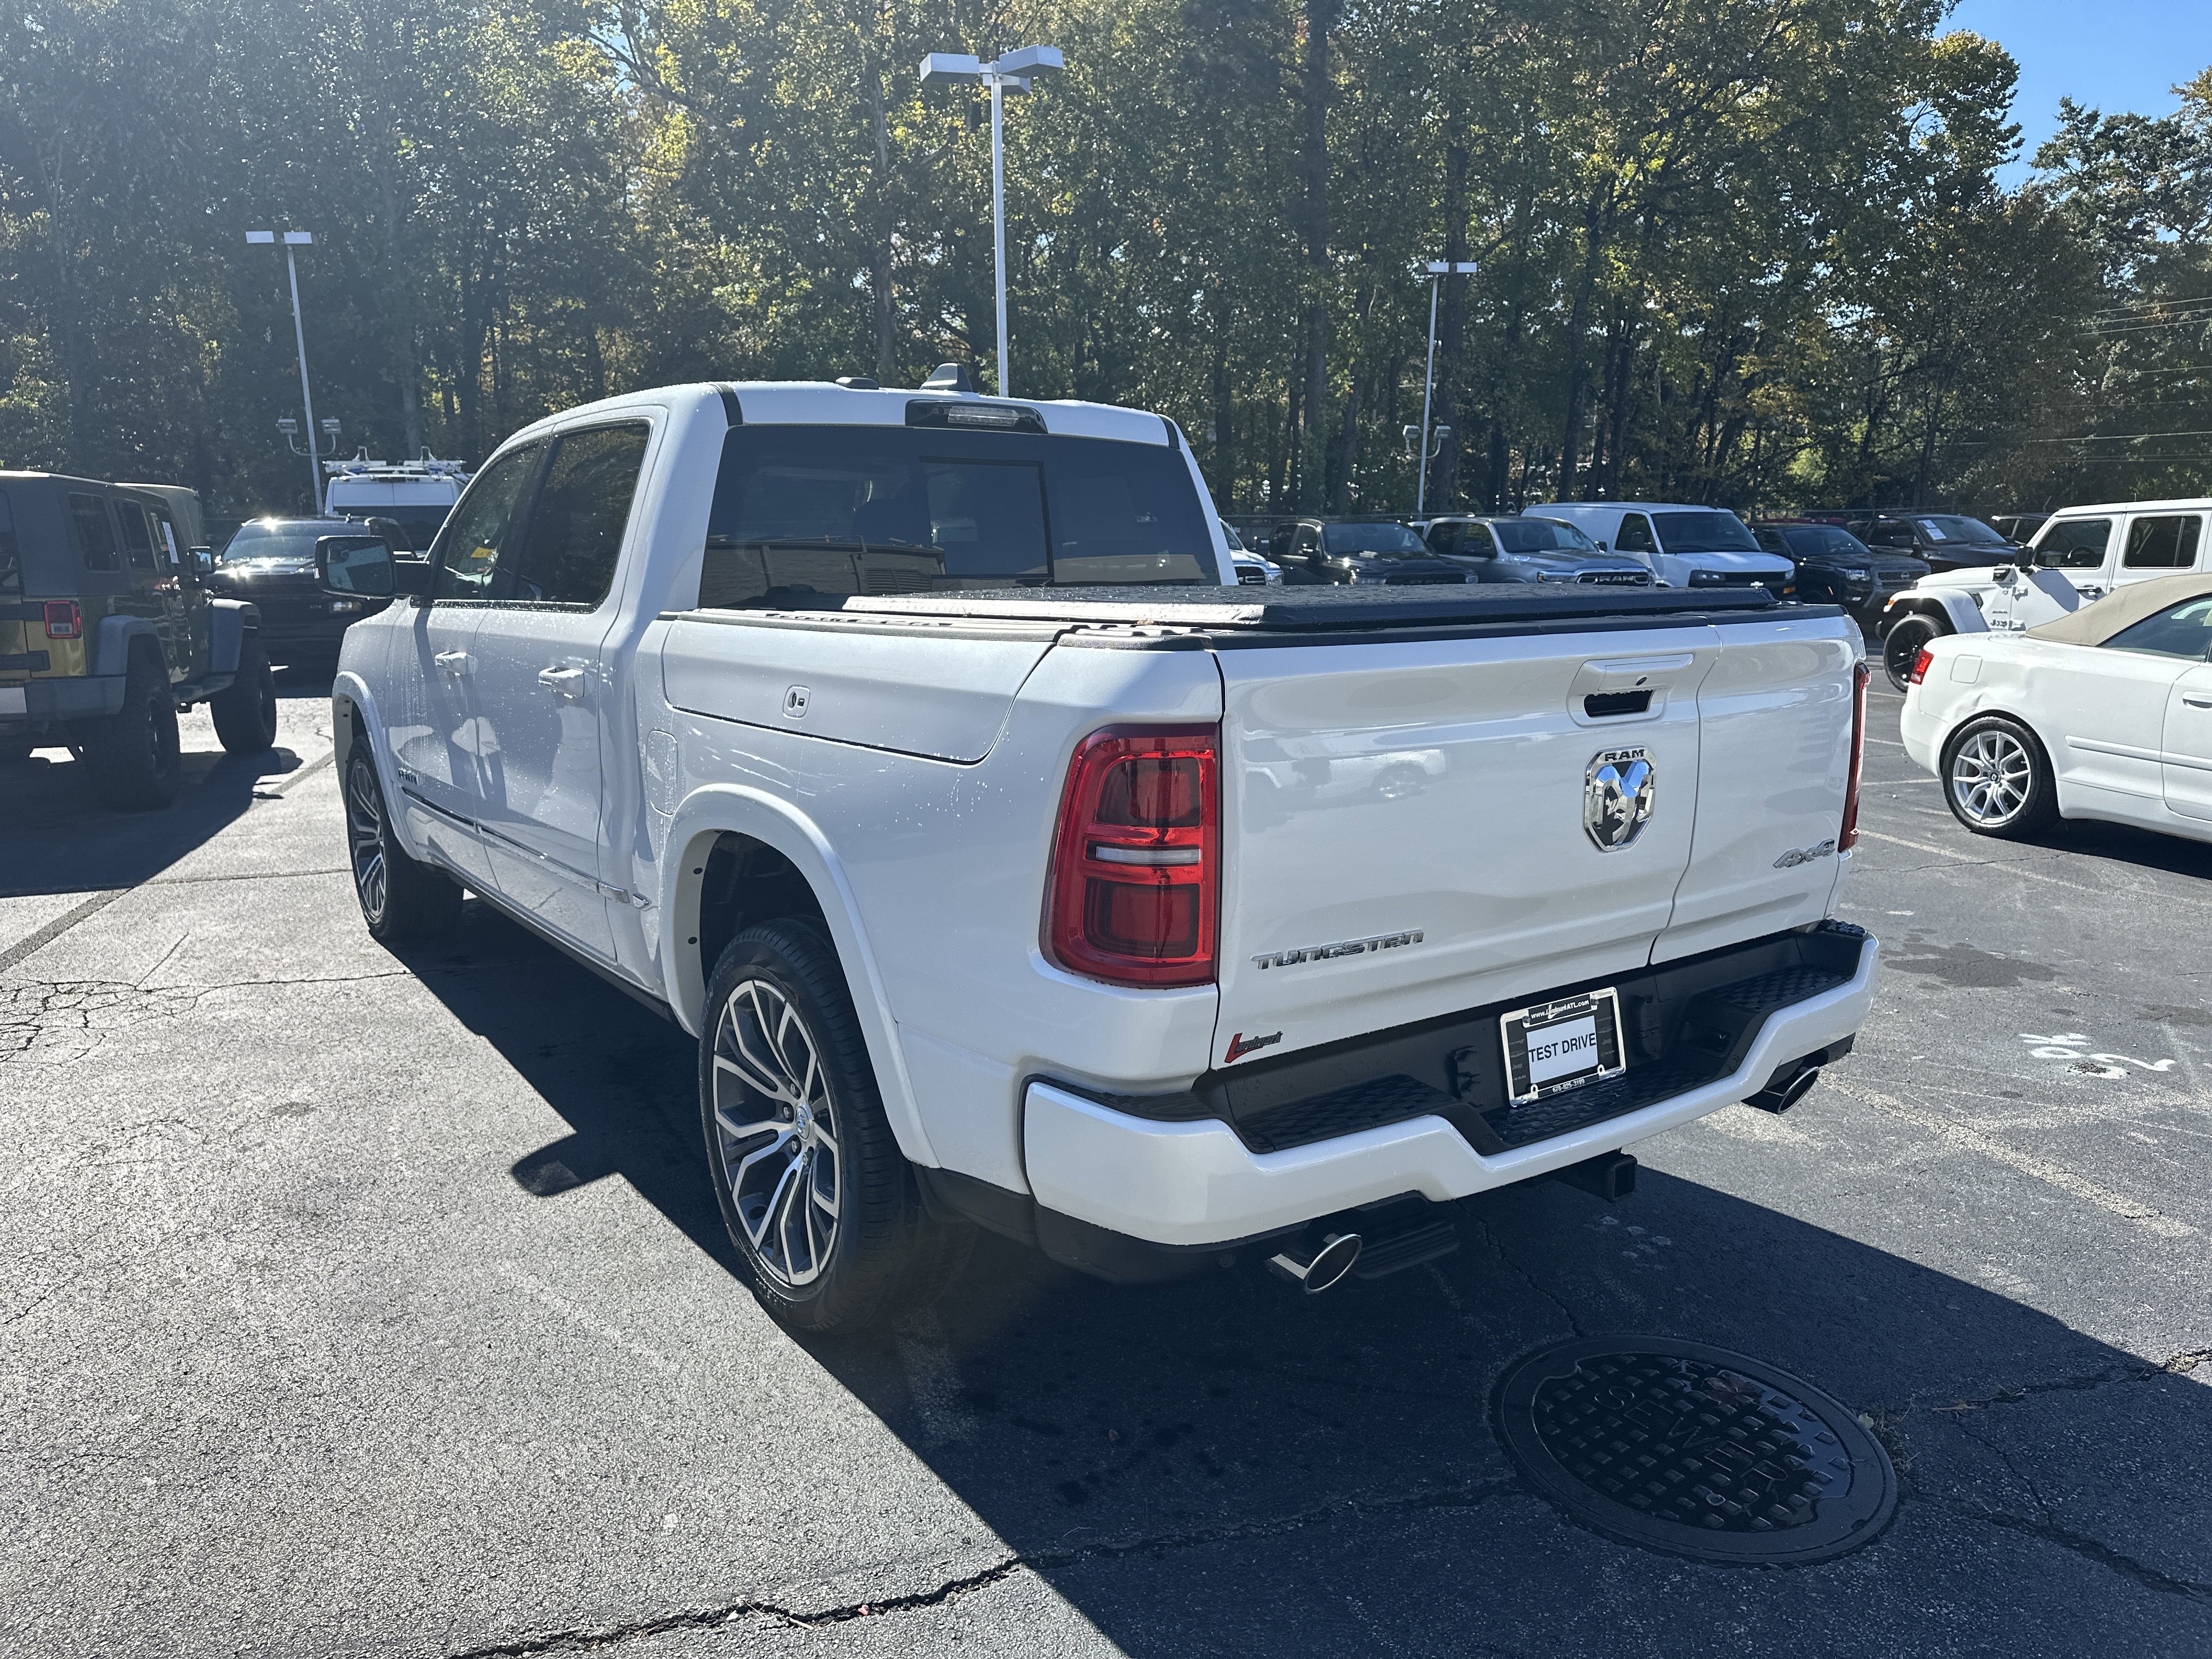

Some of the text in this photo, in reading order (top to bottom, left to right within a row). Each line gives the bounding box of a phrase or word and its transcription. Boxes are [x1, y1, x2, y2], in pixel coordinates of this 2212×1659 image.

[1604, 748, 1645, 762] RAM
[1250, 929, 1424, 970] TUNGSTEN
[1224, 1030, 1283, 1064] Landmark
[1528, 1032, 1596, 1063] TEST DRIVE
[1552, 1079, 1585, 1093] 678-825-3199
